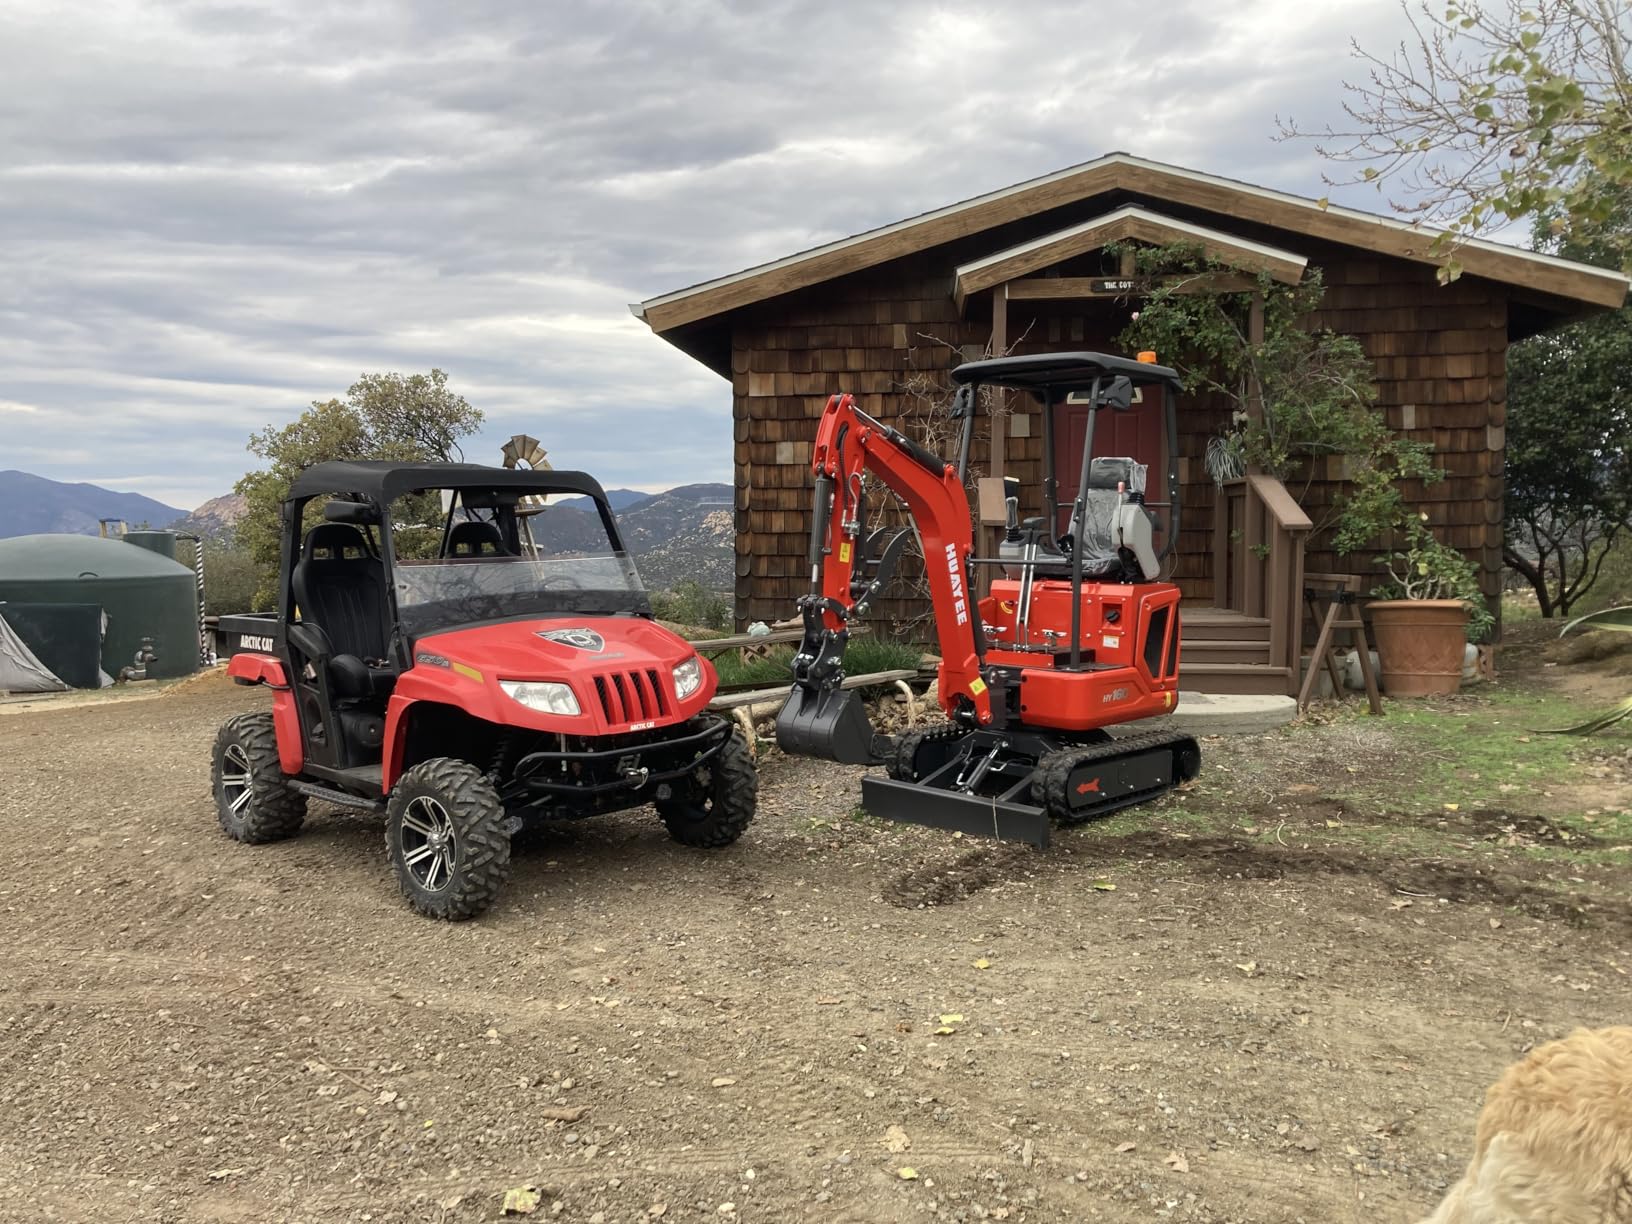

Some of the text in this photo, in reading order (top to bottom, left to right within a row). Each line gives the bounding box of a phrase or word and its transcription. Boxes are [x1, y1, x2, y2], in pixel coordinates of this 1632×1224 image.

[1104, 281, 1117, 289] THE
[945, 542, 968, 626] HUAYEE
[240, 634, 274, 652] ARCTIC CAT
